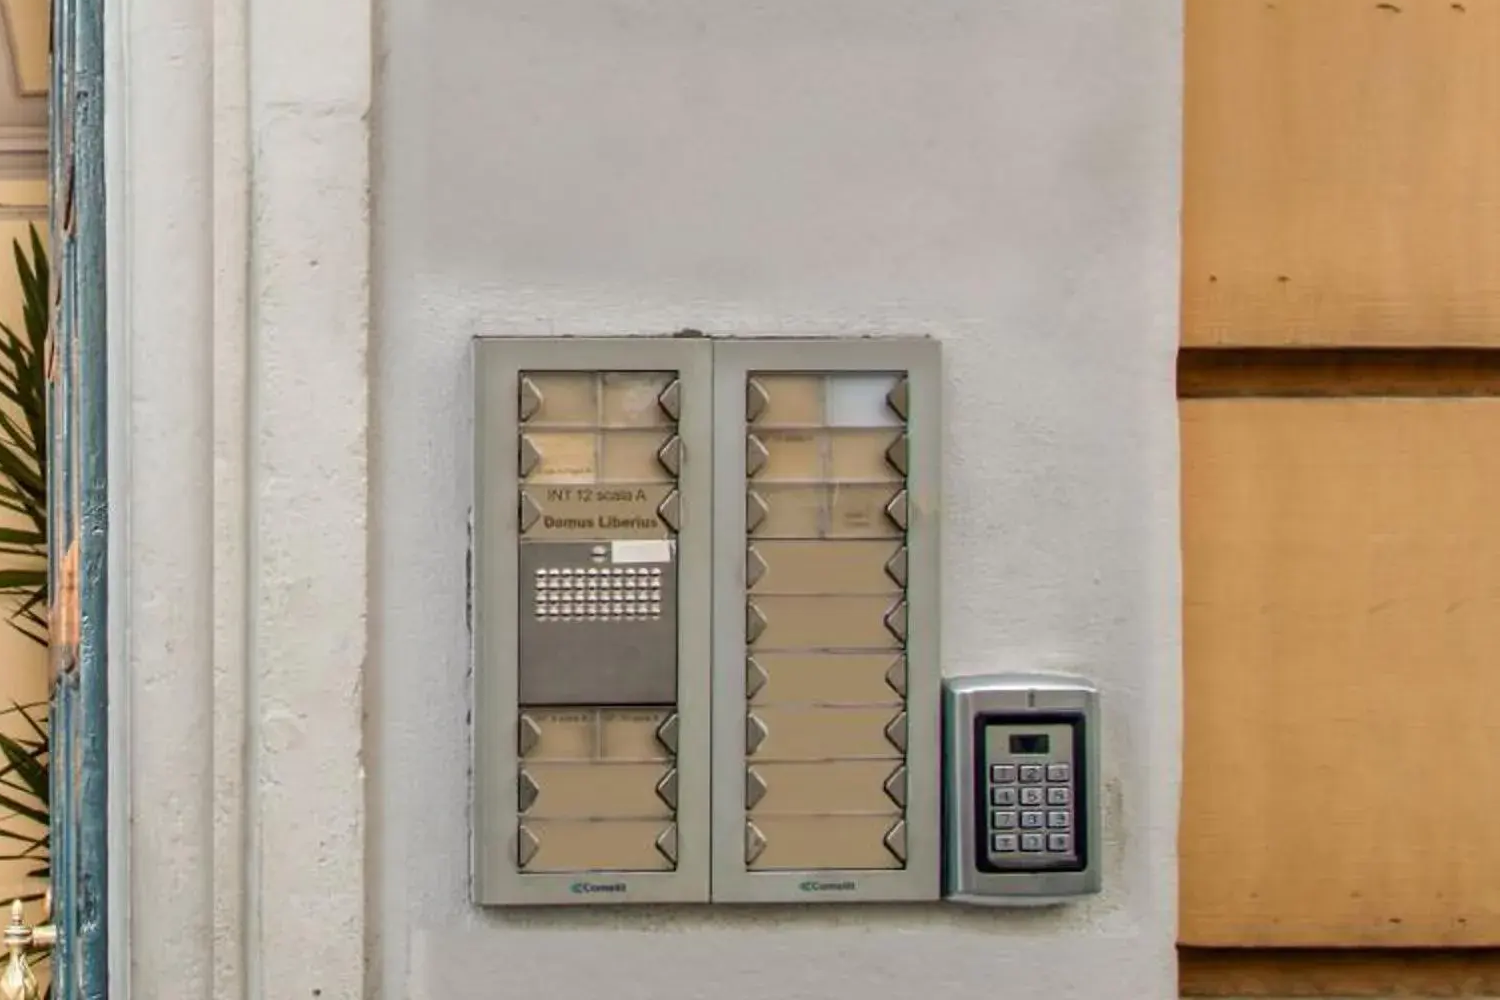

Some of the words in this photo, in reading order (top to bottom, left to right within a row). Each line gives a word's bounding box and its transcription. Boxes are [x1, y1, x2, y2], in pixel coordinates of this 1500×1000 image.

[577, 488, 593, 502] 12
[635, 488, 647, 501] A
[544, 515, 595, 529] Domus
[598, 515, 659, 529] Liberius
